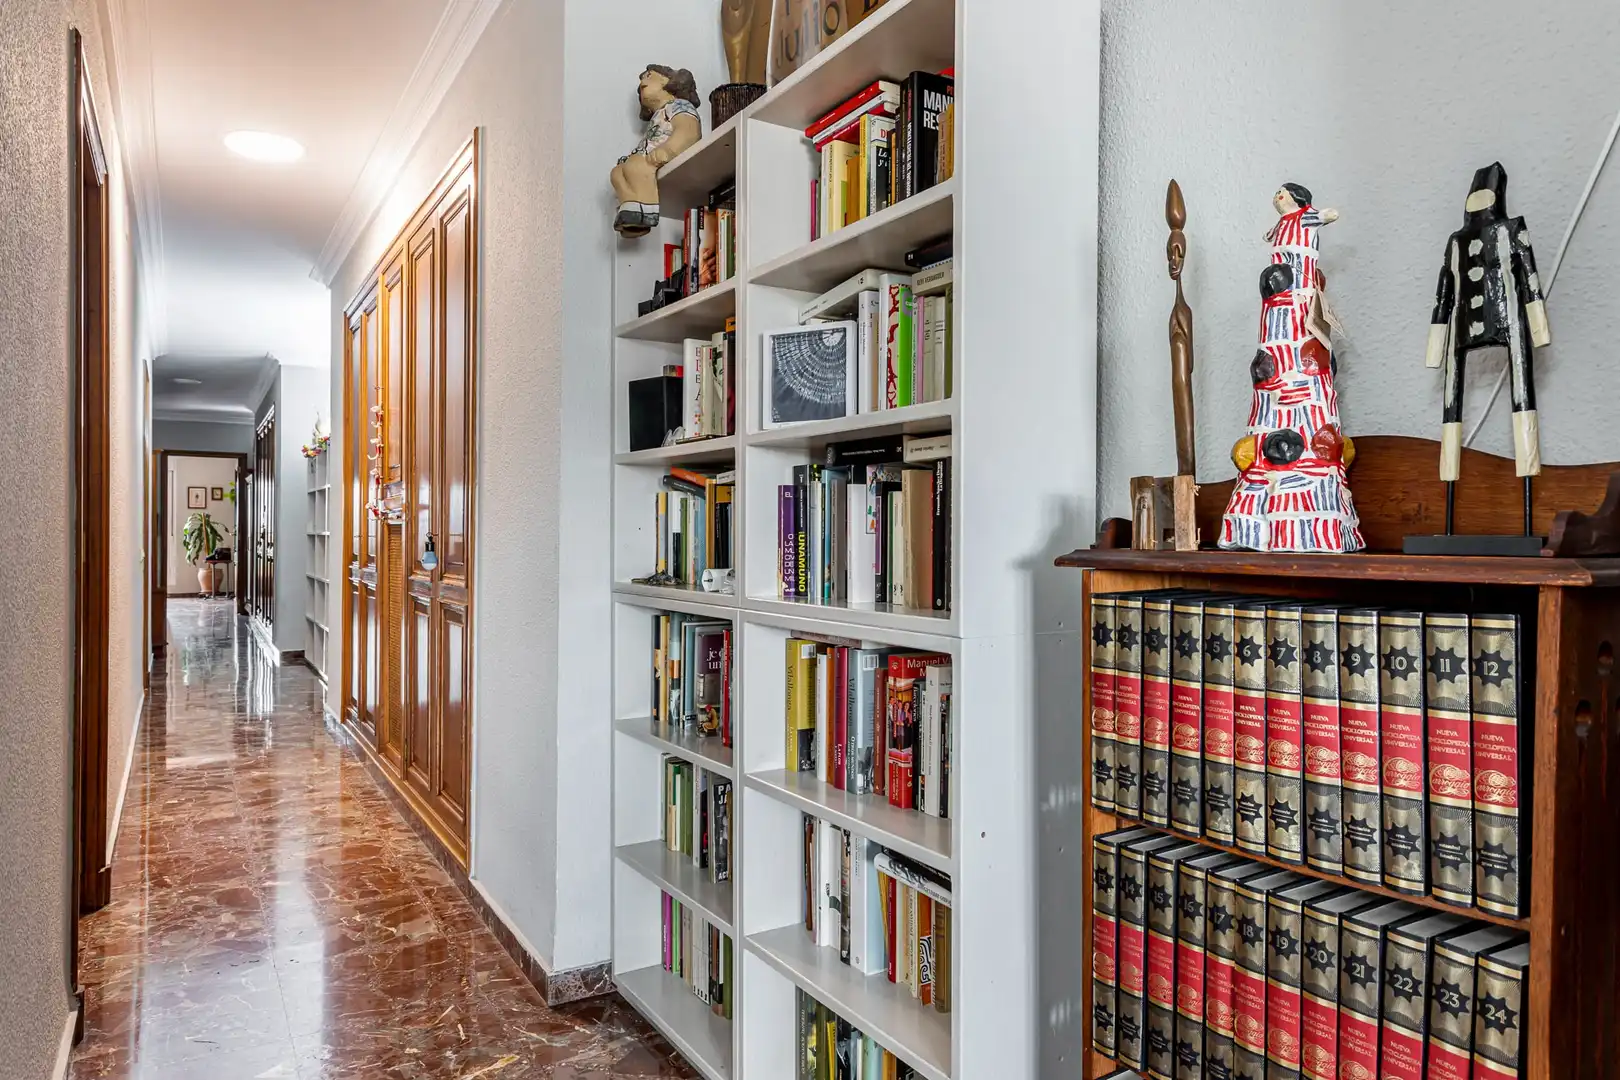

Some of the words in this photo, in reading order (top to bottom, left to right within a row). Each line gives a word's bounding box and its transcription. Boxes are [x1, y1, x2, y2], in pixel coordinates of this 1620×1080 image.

[798, 534, 806, 593] UNAMUNO
[1122, 631, 1129, 643] 2
[1151, 634, 1159, 646] 3
[1181, 639, 1190, 651] 4
[1212, 641, 1221, 652] 5
[1242, 645, 1251, 657] 6
[1276, 647, 1286, 660] 7
[1313, 651, 1322, 664] 8
[1351, 652, 1361, 666] 9
[1390, 656, 1408, 671] 10
[1440, 658, 1451, 673] 11
[1483, 661, 1500, 677] 12
[1436, 729, 1459, 737] NUEVA
[1480, 734, 1505, 743] NUEVA
[1430, 745, 1466, 756] UNIVERSAL
[1475, 751, 1512, 761] UNIVERSAL
[1125, 881, 1134, 893] 14
[1154, 892, 1164, 904] 15
[1184, 901, 1195, 913] 16
[1214, 912, 1225, 925] 17
[1243, 923, 1254, 938] 18
[1276, 934, 1289, 950] 19
[1309, 946, 1328, 964] 20
[1351, 962, 1365, 979] 21
[1393, 973, 1413, 993] 22
[1440, 988, 1460, 1008] 23
[1485, 1003, 1507, 1025] 24
